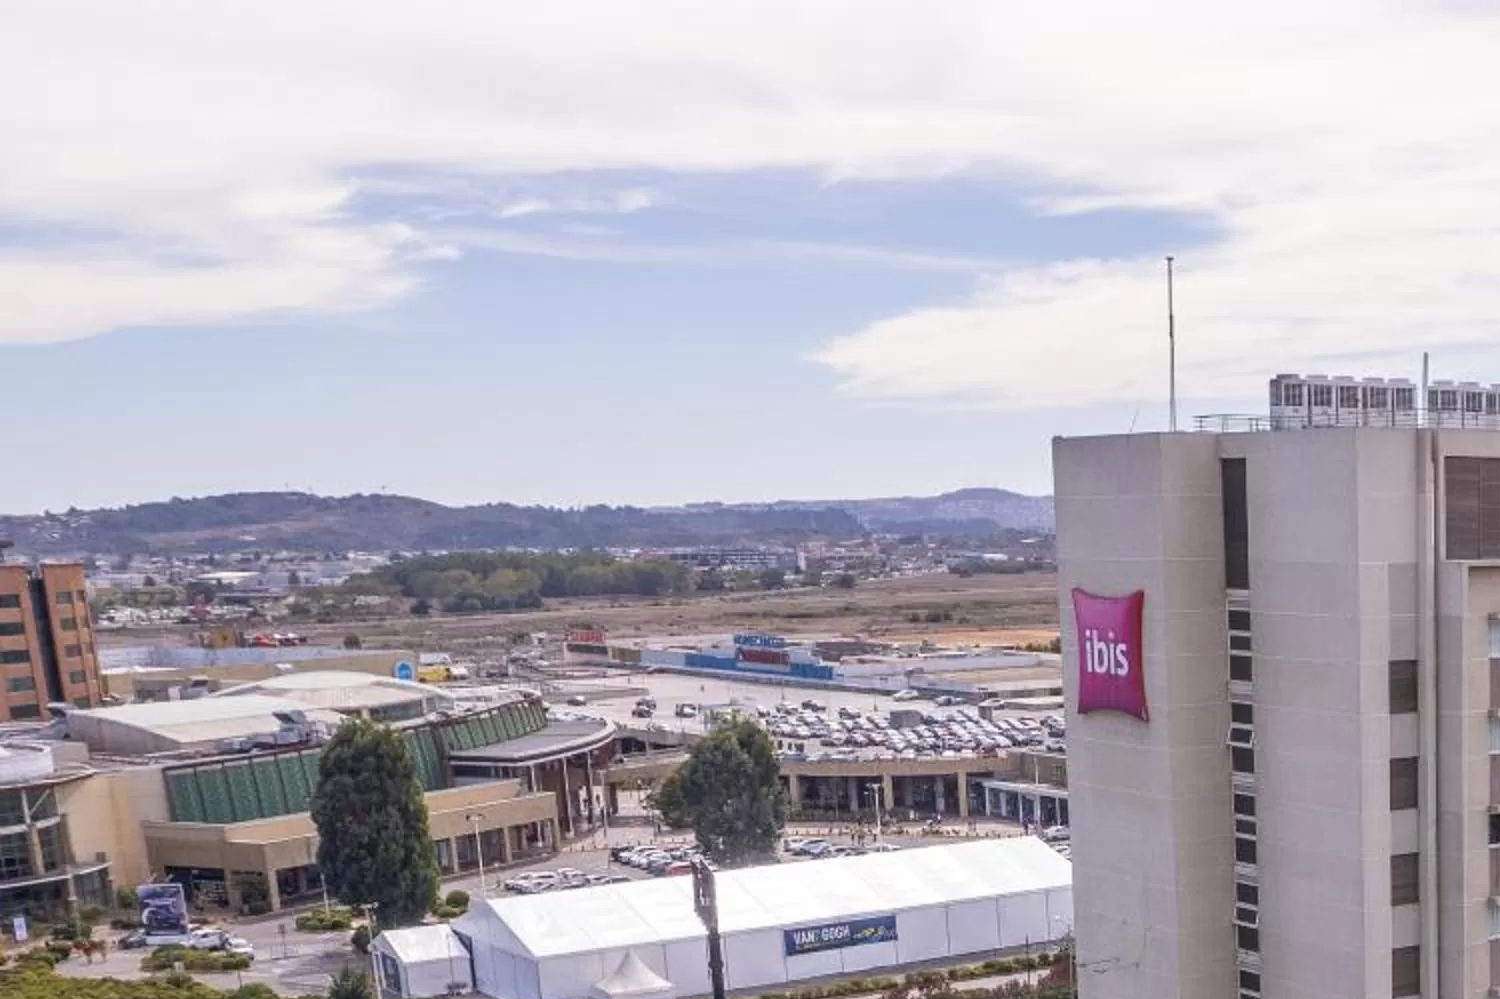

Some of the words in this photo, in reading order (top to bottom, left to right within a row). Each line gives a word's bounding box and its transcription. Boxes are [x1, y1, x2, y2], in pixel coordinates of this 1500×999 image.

[1085, 629, 1129, 676] ibis
[793, 929, 815, 945] VAN
[822, 925, 851, 941] GOGH
